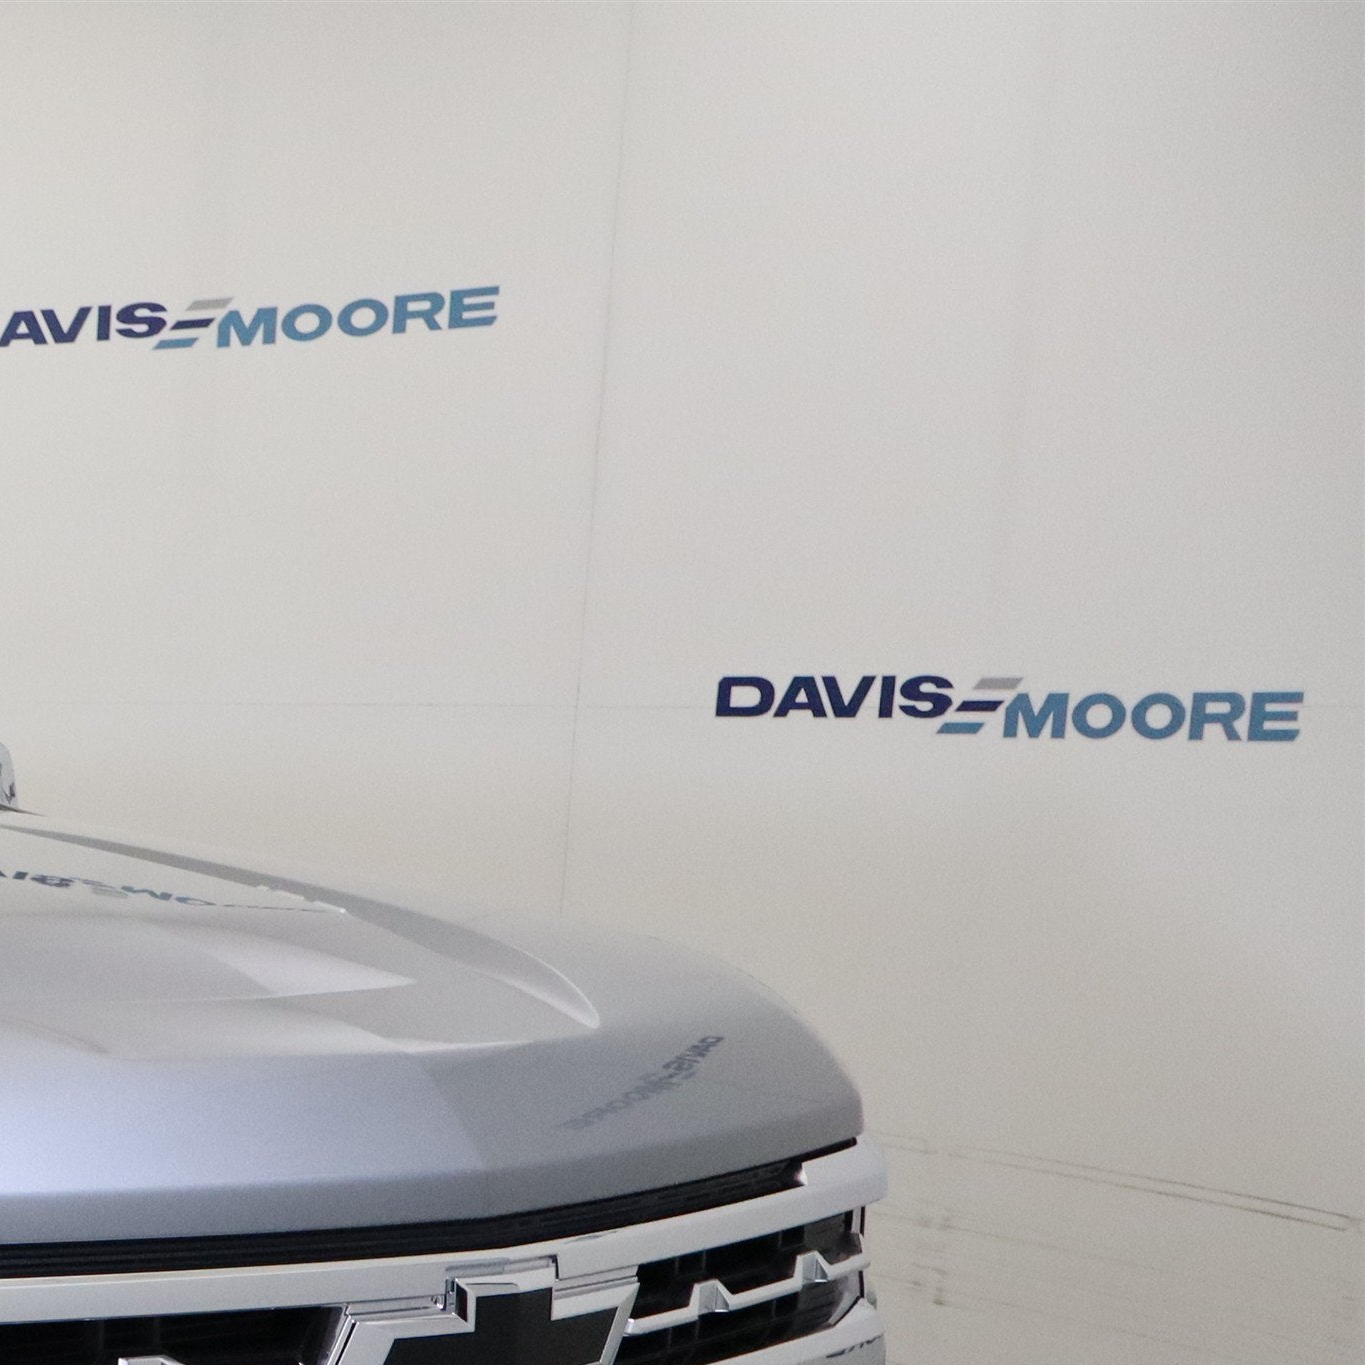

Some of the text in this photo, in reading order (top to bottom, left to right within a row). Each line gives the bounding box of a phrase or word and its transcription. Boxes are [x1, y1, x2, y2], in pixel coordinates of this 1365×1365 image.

[216, 285, 500, 349] MOORE
[714, 674, 1305, 743] DAVIS MOORE
